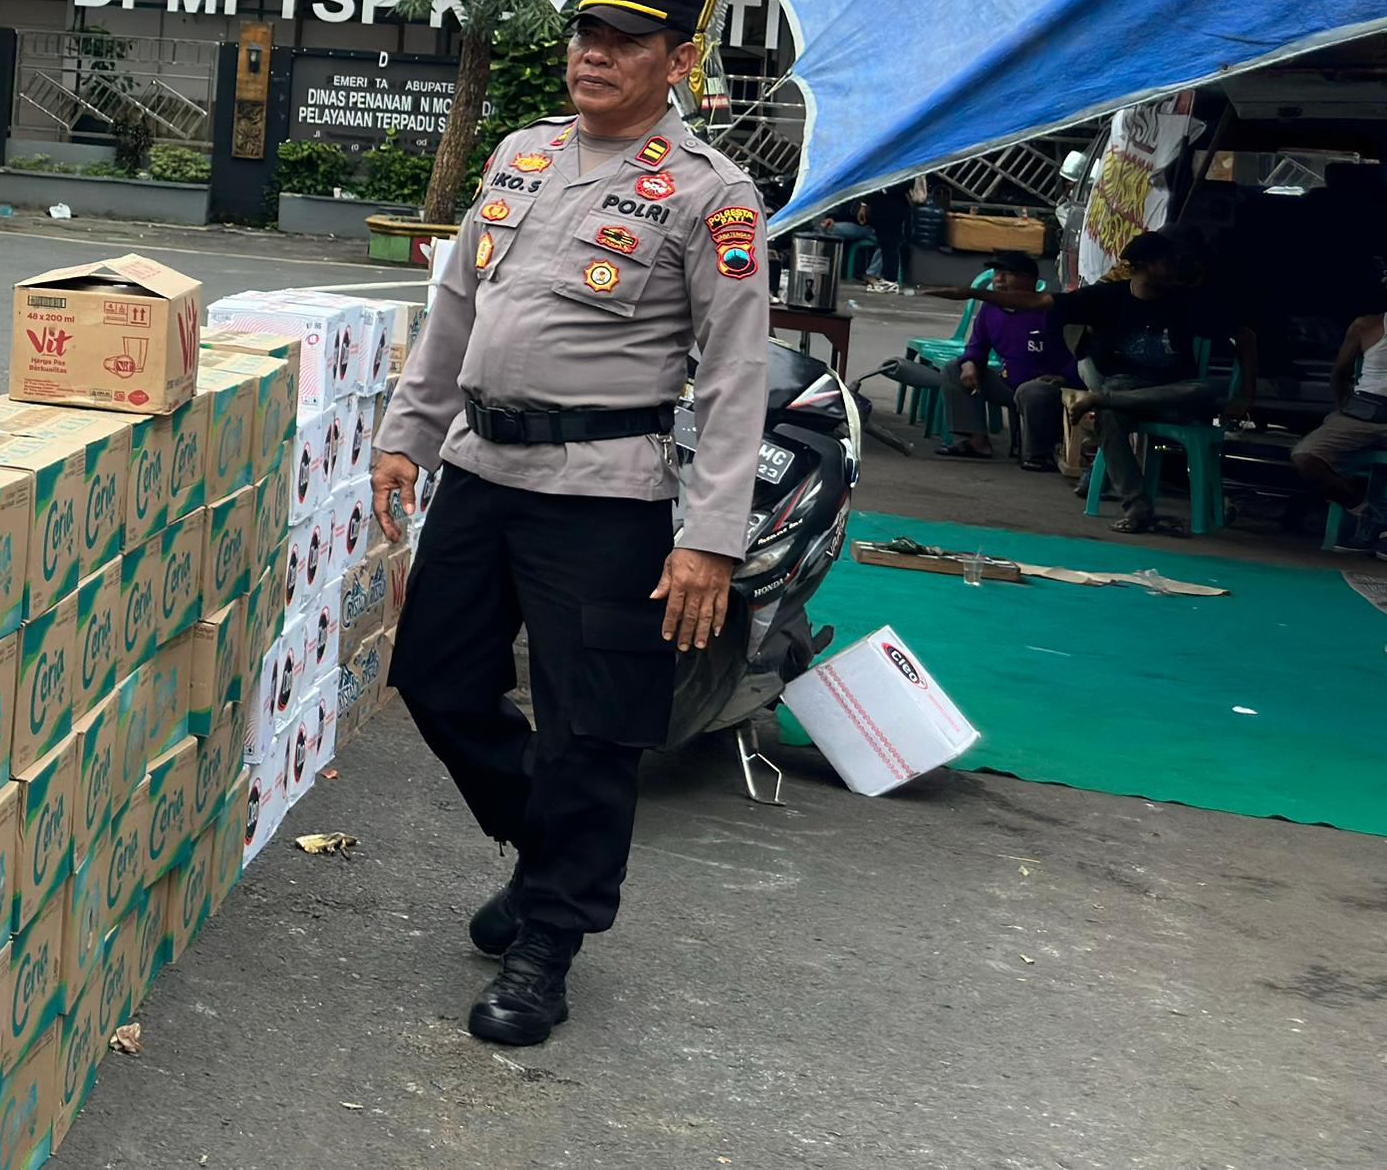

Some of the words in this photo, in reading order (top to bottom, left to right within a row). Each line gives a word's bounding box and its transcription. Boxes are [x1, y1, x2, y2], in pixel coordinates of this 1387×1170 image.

[405, 80, 455, 94] ABUPATE
[307, 89, 345, 107] DINAS
[433, 100, 452, 114] MO
[298, 107, 372, 127] PELAYANAN
[376, 113, 434, 131] TERPADU
[602, 193, 670, 225] POLRI
[708, 208, 754, 225] POLRESTA
[45, 314, 62, 322] 200
[64, 315, 75, 323] ml
[26, 327, 73, 357] Vit
[29, 364, 67, 374] Berkualitas
[31, 357, 52, 366] Harga
[54, 358, 66, 366] Pas
[759, 444, 787, 466] MG
[758, 465, 778, 478] 23
[85, 473, 115, 549] Ceria
[43, 498, 74, 581] Ceria
[754, 578, 783, 598] HONDA
[83, 608, 111, 689] Ceria
[891, 651, 918, 682] Cleo
[30, 649, 64, 734] Ceria
[150, 786, 183, 860] Ceria
[34, 794, 63, 886] Ceria
[12, 940, 48, 1038] Ceria
